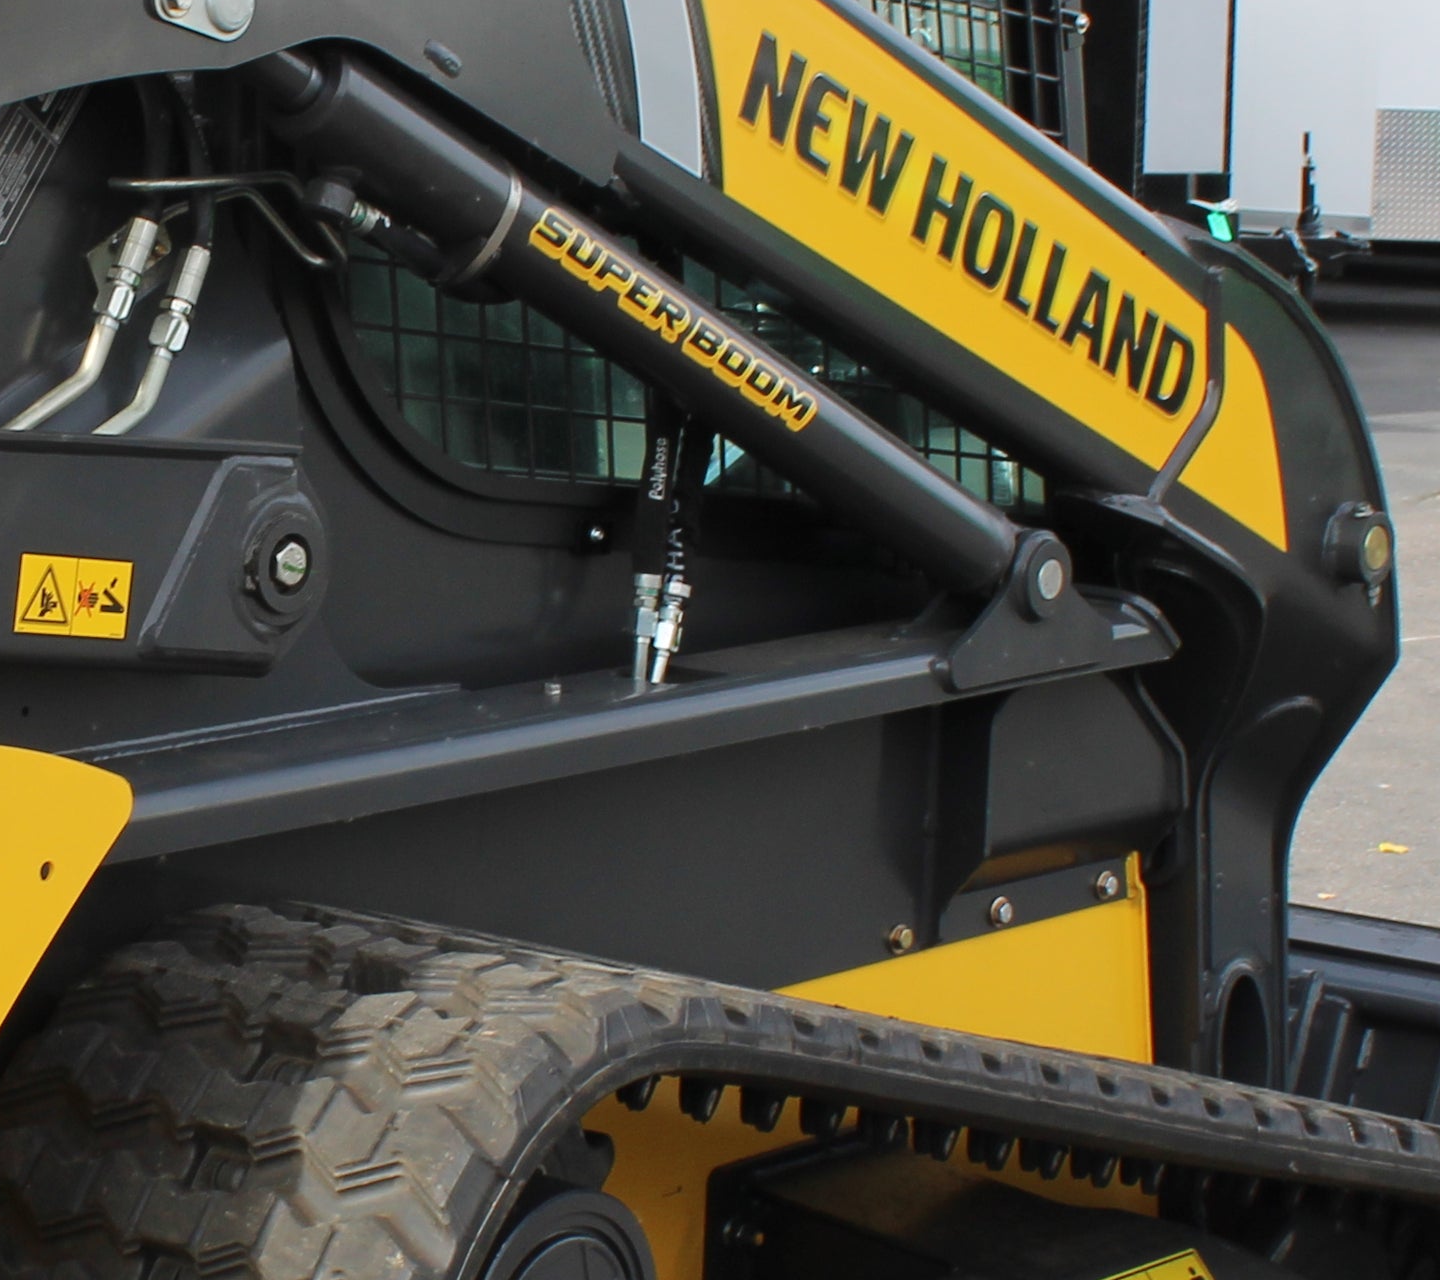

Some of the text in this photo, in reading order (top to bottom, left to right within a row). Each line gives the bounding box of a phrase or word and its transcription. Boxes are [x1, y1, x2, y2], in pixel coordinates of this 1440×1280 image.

[528, 206, 819, 433] SUPER BOOM
[739, 30, 1196, 418] NEW HOLLAND
[648, 437, 669, 501] Polyhose
